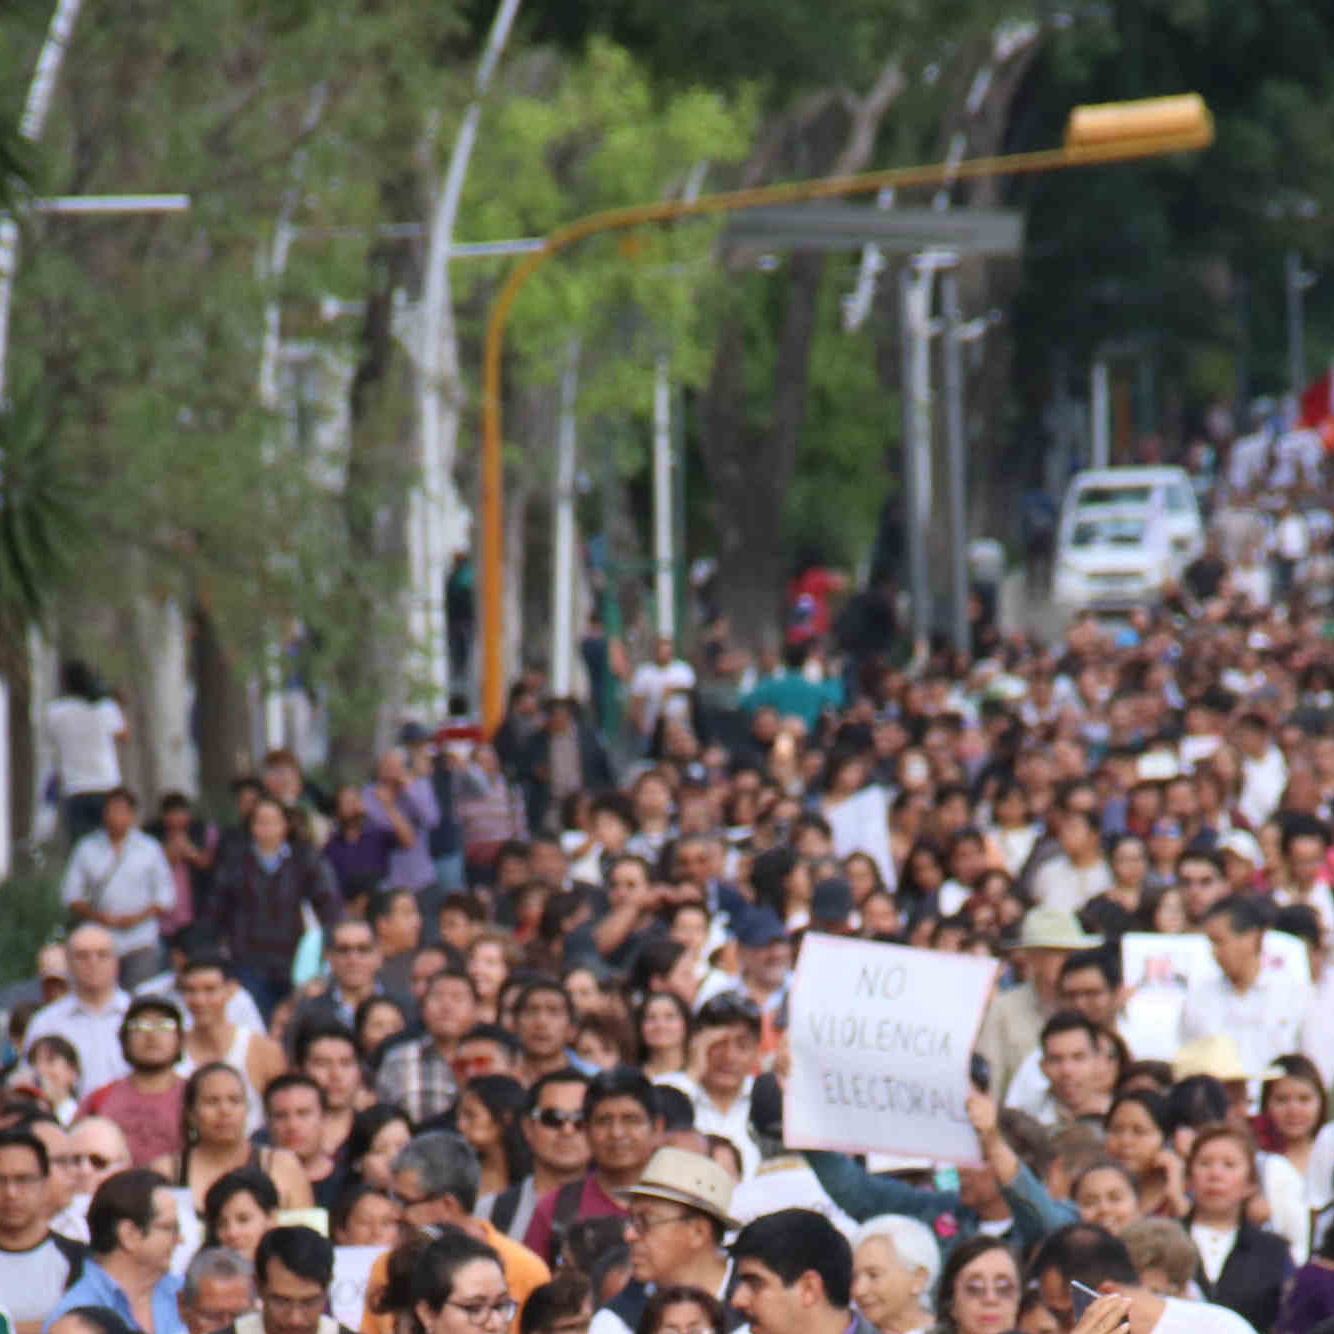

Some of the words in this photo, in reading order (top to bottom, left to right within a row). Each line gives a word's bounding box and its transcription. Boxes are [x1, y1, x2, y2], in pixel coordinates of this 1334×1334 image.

[856, 961, 908, 1000] NO
[808, 1011, 953, 1057] VIOLENCIA
[824, 1071, 967, 1123] ELECTORAL
